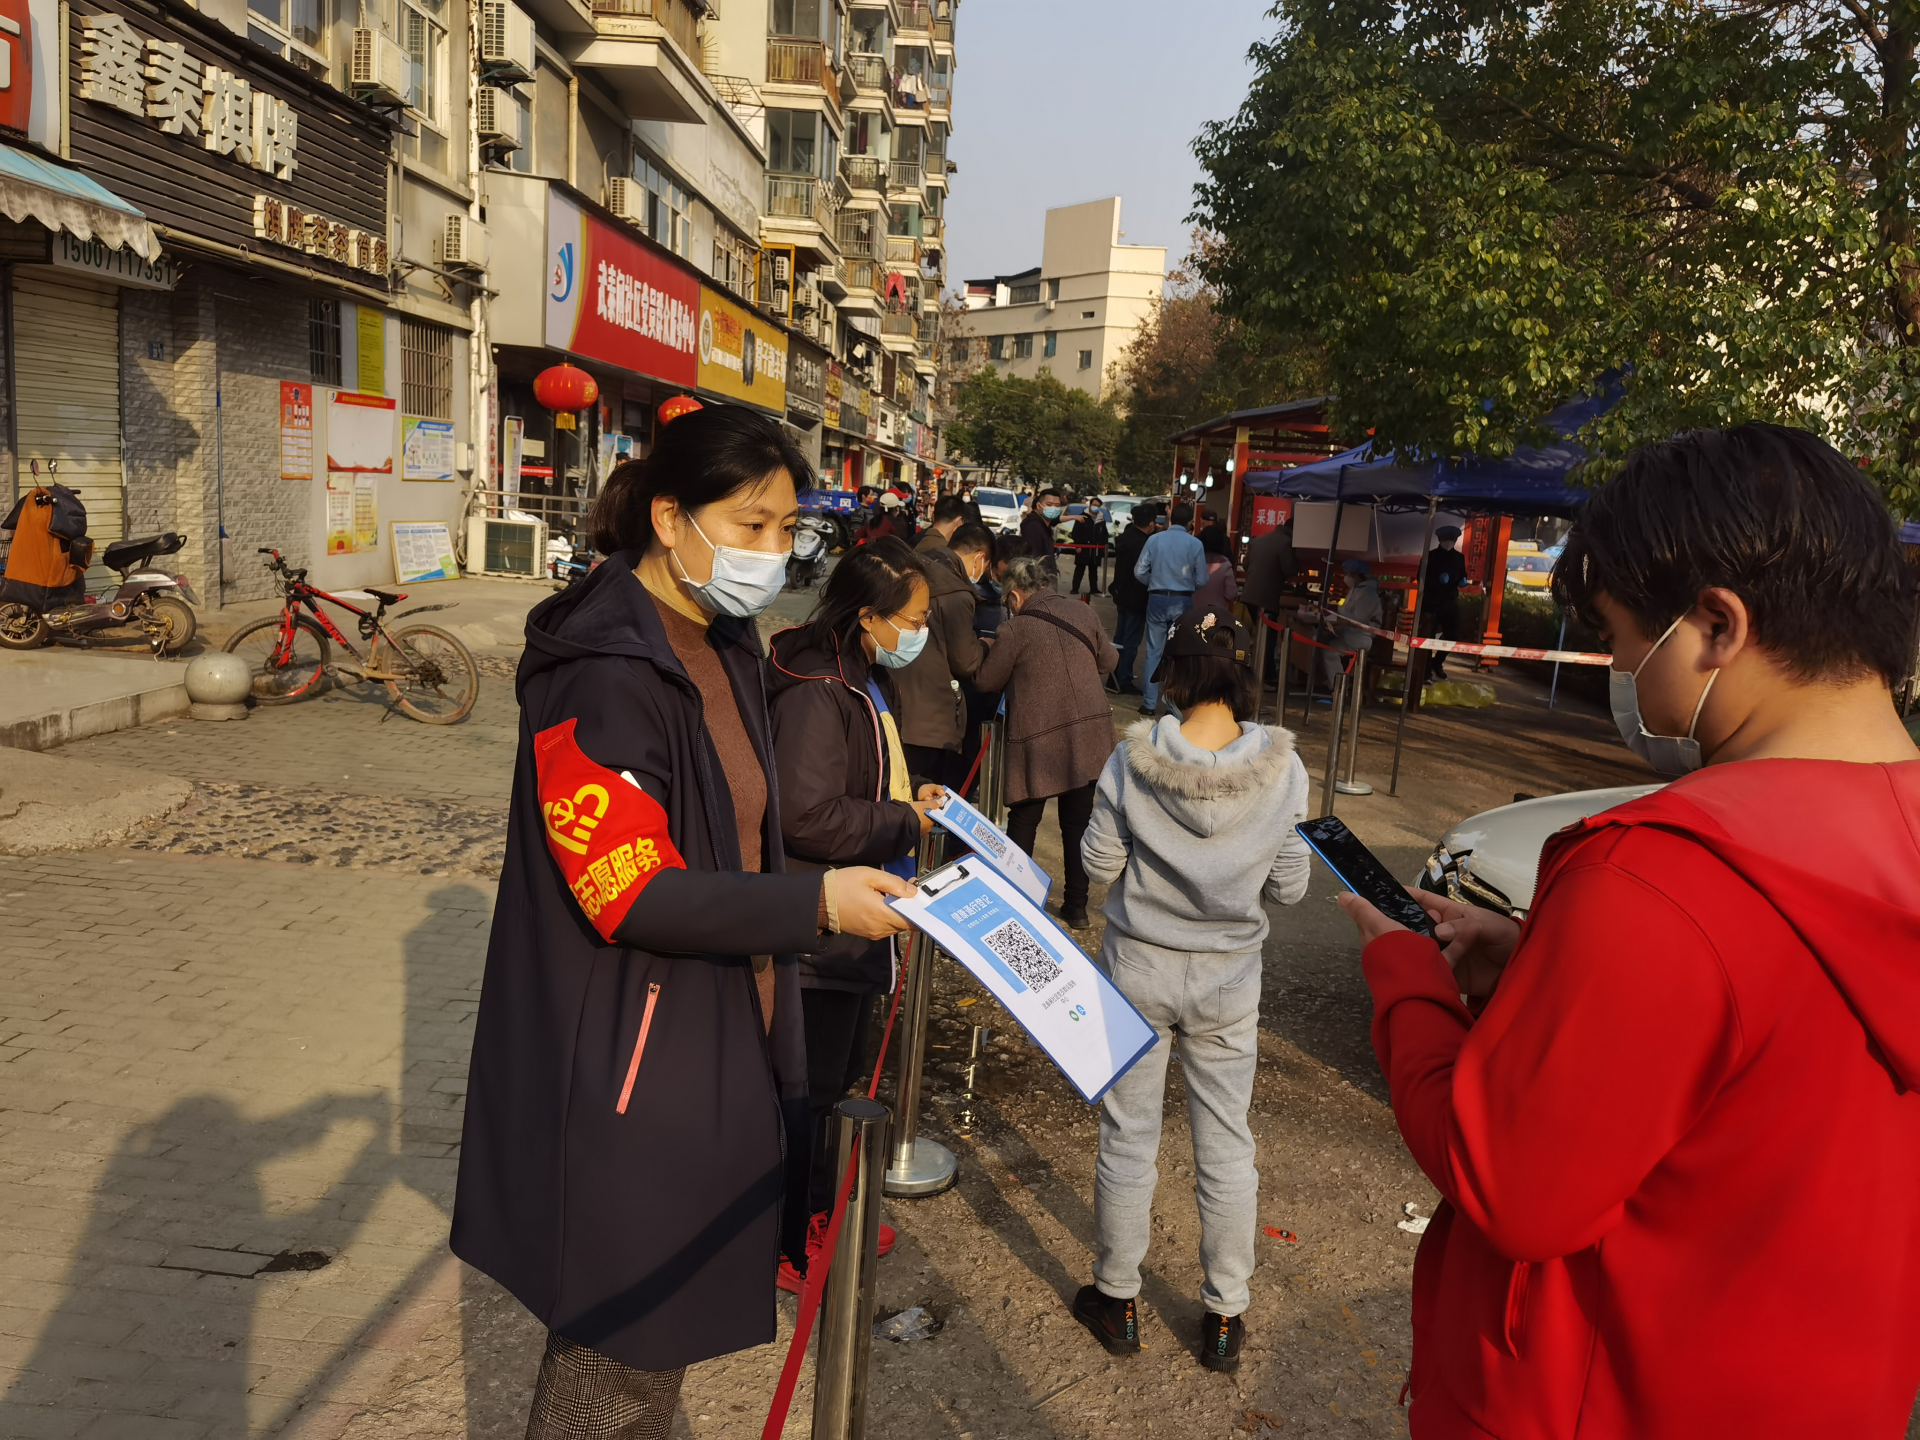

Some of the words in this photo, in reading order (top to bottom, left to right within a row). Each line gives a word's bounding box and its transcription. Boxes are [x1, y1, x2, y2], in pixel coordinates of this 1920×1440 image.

[80, 13, 299, 182] 鑫泰棋牌
[254, 195, 388, 277] 棋牌茗茶简餐
[597, 259, 696, 355] 武泰闸社区党员群众服务中心
[1196, 484, 1207, 504] 2
[1256, 508, 1287, 526] 采集区
[569, 836, 662, 921] 志愿服务
[950, 893, 994, 924] 健康通行登记
